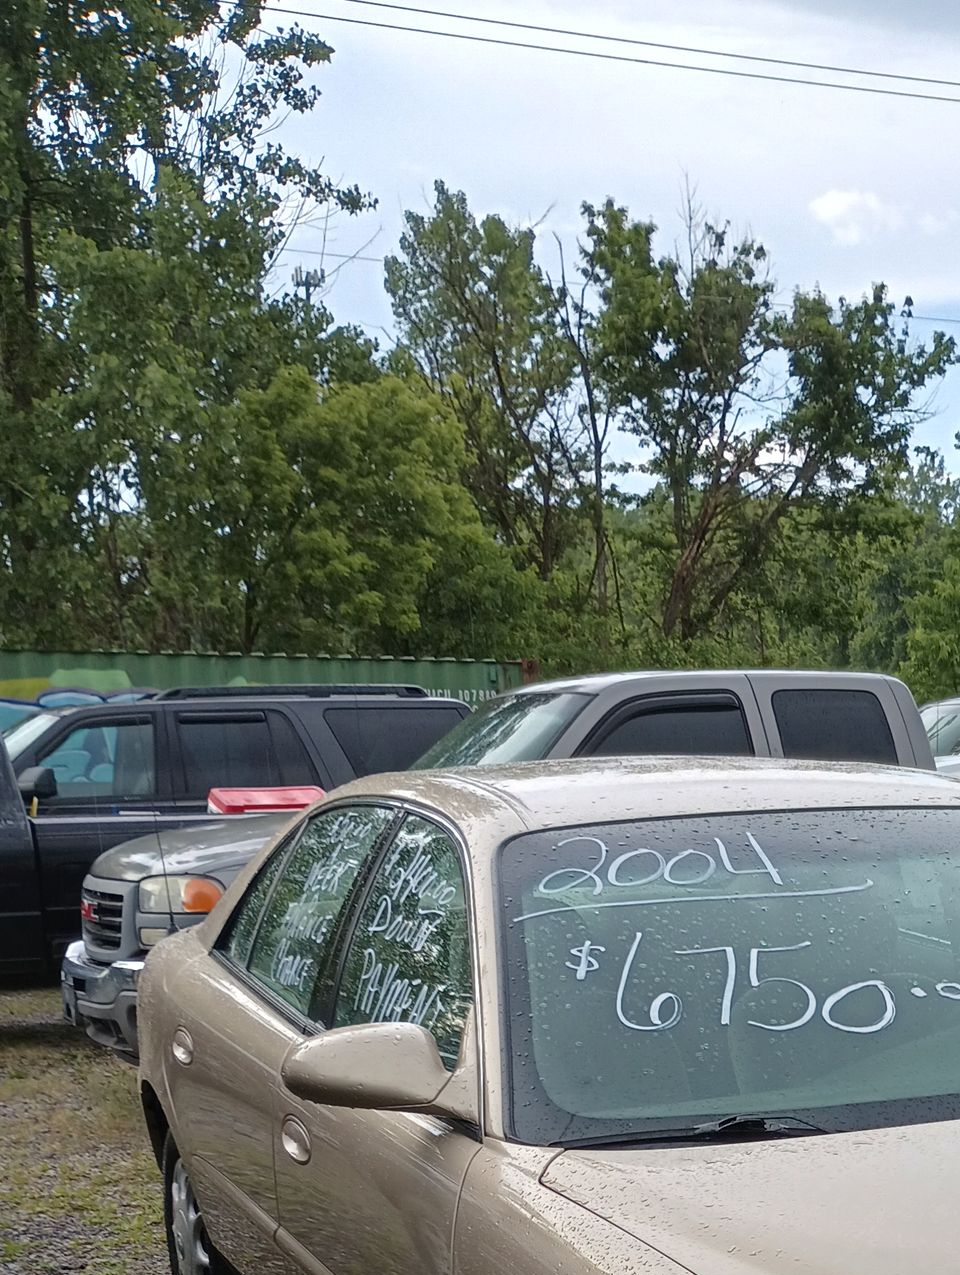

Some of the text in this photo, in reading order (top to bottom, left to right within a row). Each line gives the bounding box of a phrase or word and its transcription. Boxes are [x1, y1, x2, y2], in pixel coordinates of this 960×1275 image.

[303, 861, 358, 895] WEEK
[538, 831, 783, 895] 2004
[367, 895, 441, 951] DOWN
